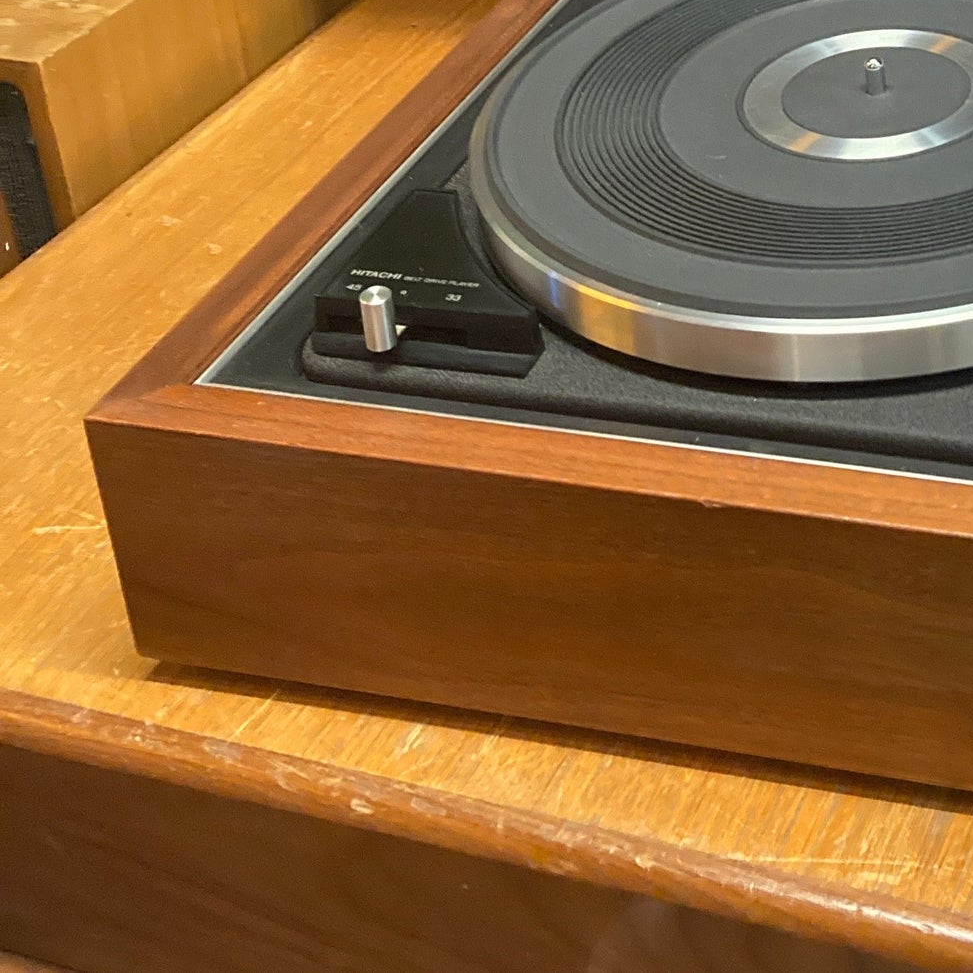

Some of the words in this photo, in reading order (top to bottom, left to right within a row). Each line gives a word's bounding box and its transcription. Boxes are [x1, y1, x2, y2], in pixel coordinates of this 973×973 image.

[350, 268, 402, 280] HITACHI
[423, 277, 448, 285] DRIVE
[447, 279, 481, 288] PLAYER
[345, 283, 363, 291] 45
[445, 293, 462, 302] 33
